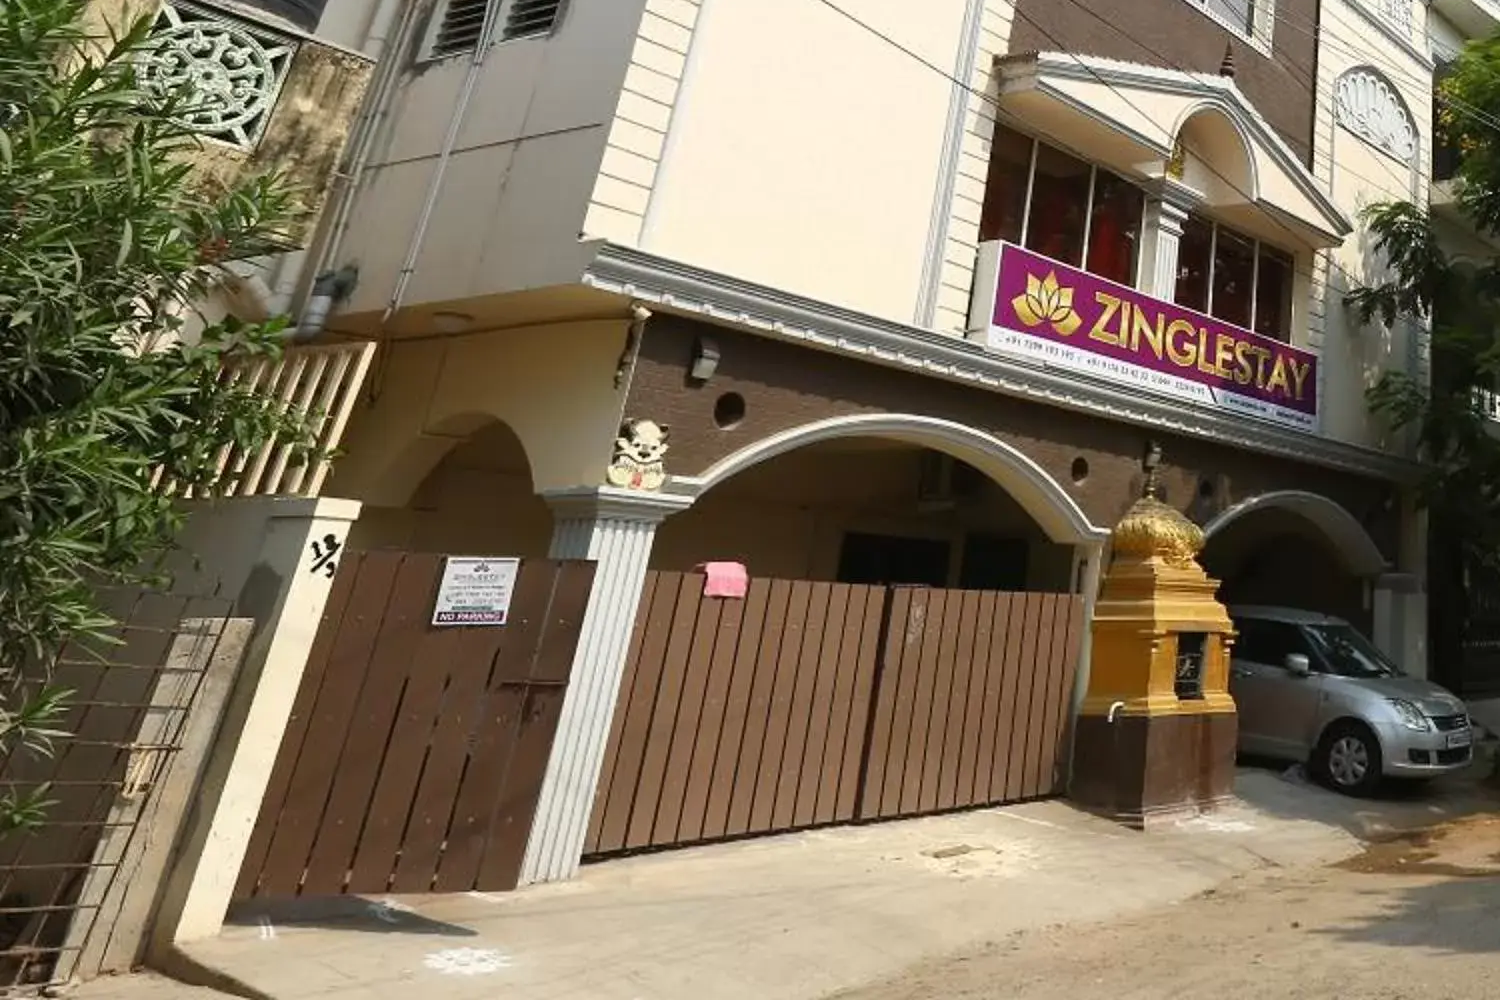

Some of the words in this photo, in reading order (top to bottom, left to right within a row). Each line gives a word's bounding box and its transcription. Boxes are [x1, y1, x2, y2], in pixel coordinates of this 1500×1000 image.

[1088, 291, 1310, 400] ZINGLESTAY
[439, 613, 455, 621] NO
[457, 612, 501, 622] PARKING
